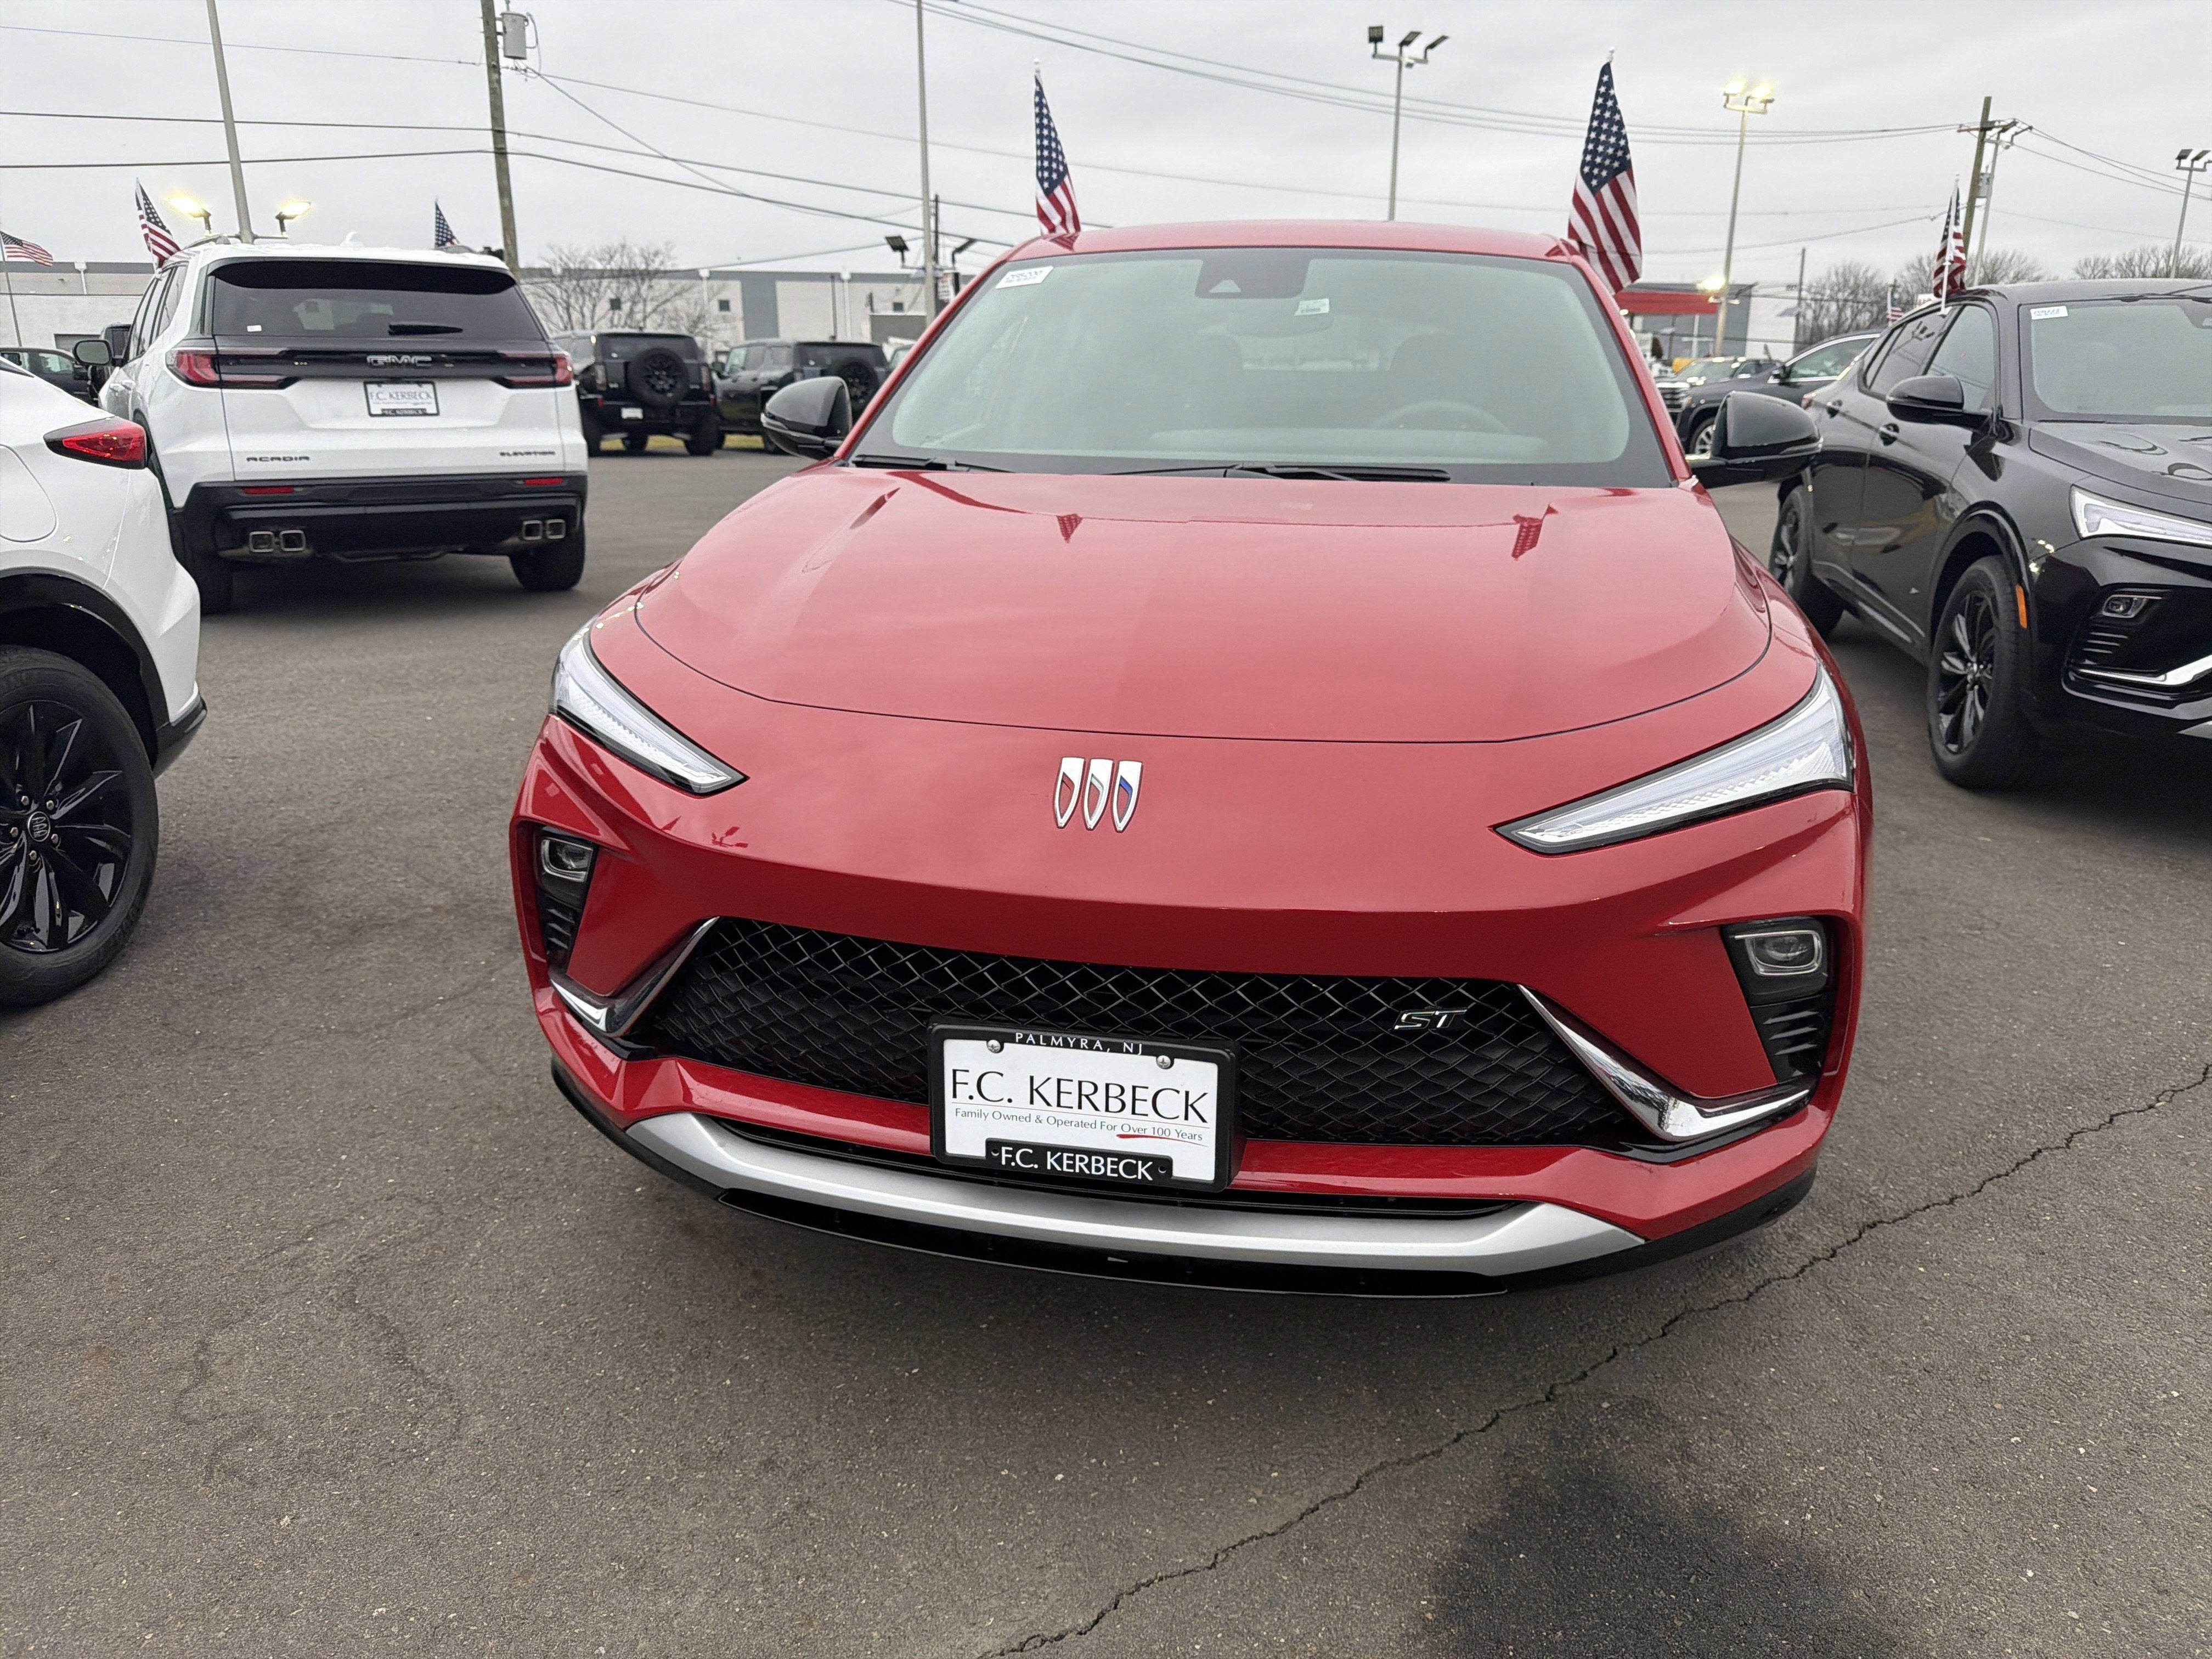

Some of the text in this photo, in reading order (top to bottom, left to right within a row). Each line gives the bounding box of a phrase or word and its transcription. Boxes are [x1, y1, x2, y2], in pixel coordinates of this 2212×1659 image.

[366, 354, 432, 368] GMC
[1393, 1009, 1469, 1030] ST
[1015, 1032, 1143, 1056] PALMYRA, NJ
[951, 1068, 1209, 1124] F.C. KERBECK
[955, 1108, 1203, 1141] Family Owned & Operated For Over 100 Years
[1001, 1146, 1154, 1181] F.C. KERBECK
